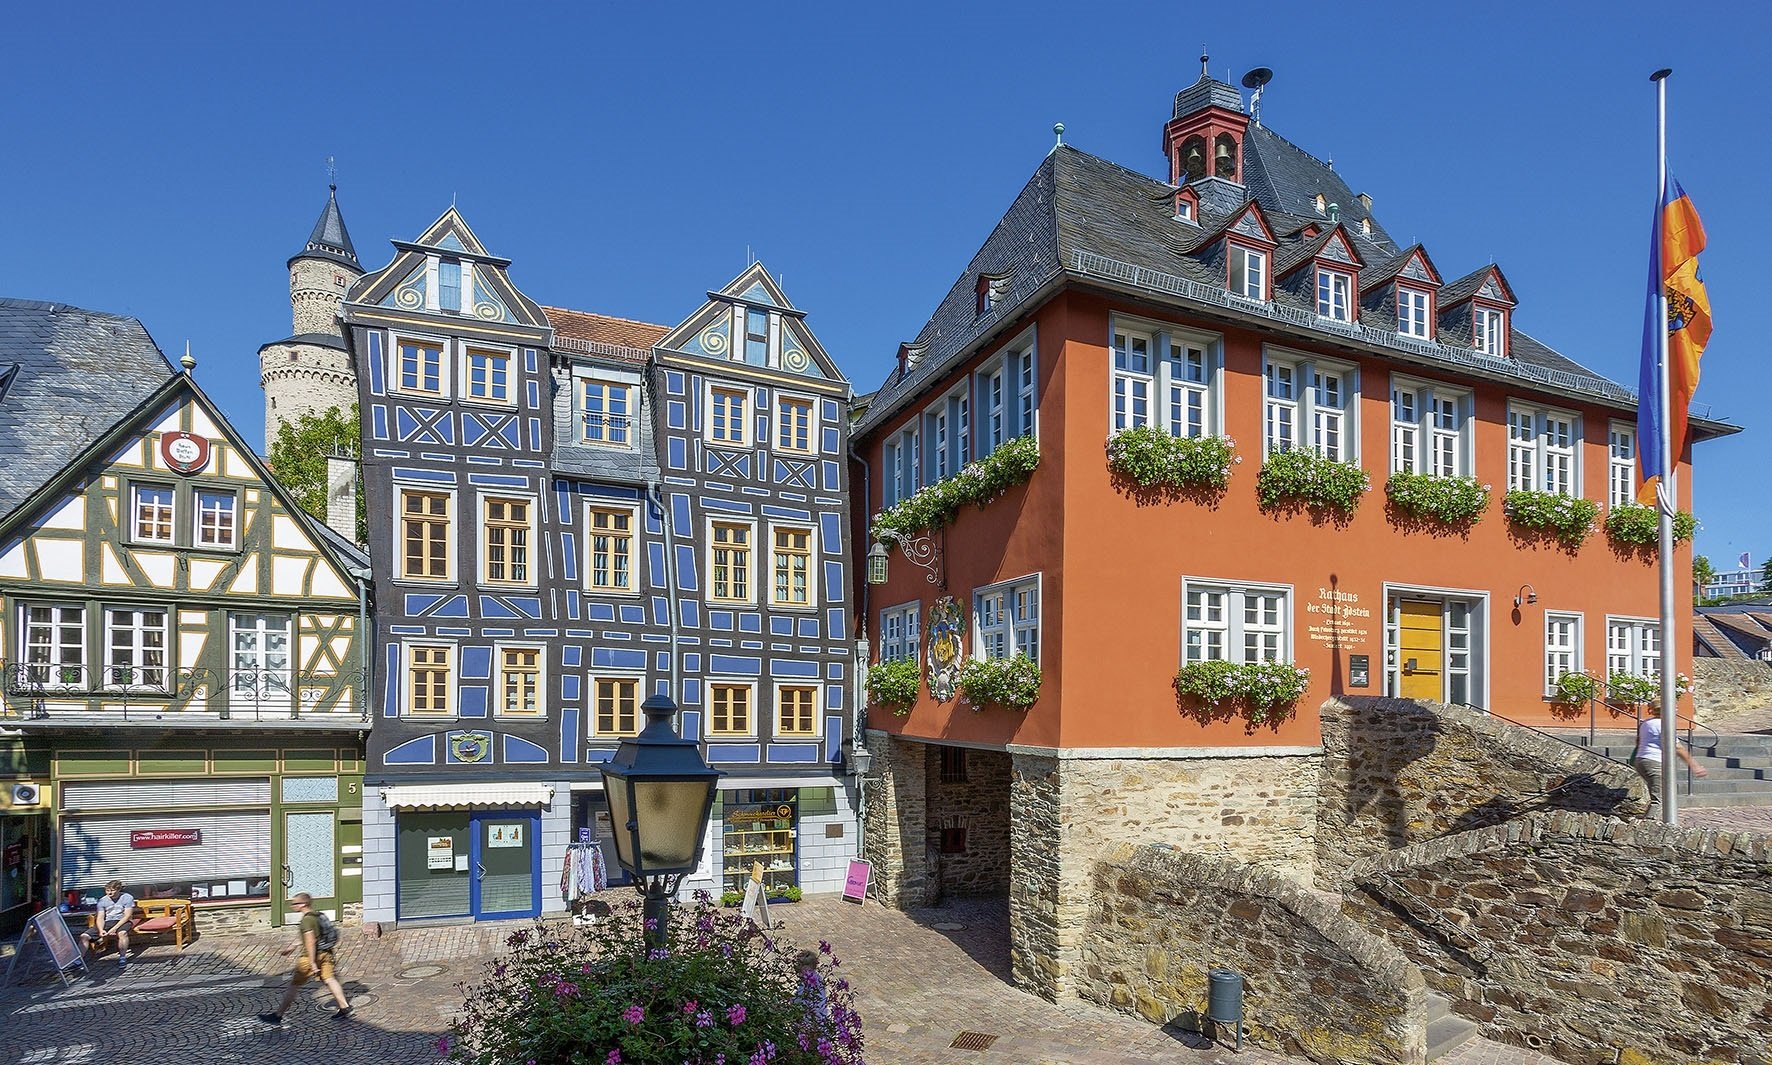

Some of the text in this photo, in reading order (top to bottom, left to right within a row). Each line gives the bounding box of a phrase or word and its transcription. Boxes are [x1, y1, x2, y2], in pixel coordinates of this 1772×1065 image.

[1318, 587, 1358, 604] Rathaus
[1307, 602, 1320, 613] der
[1321, 603, 1341, 615] Stadt
[348, 782, 357, 795] 5
